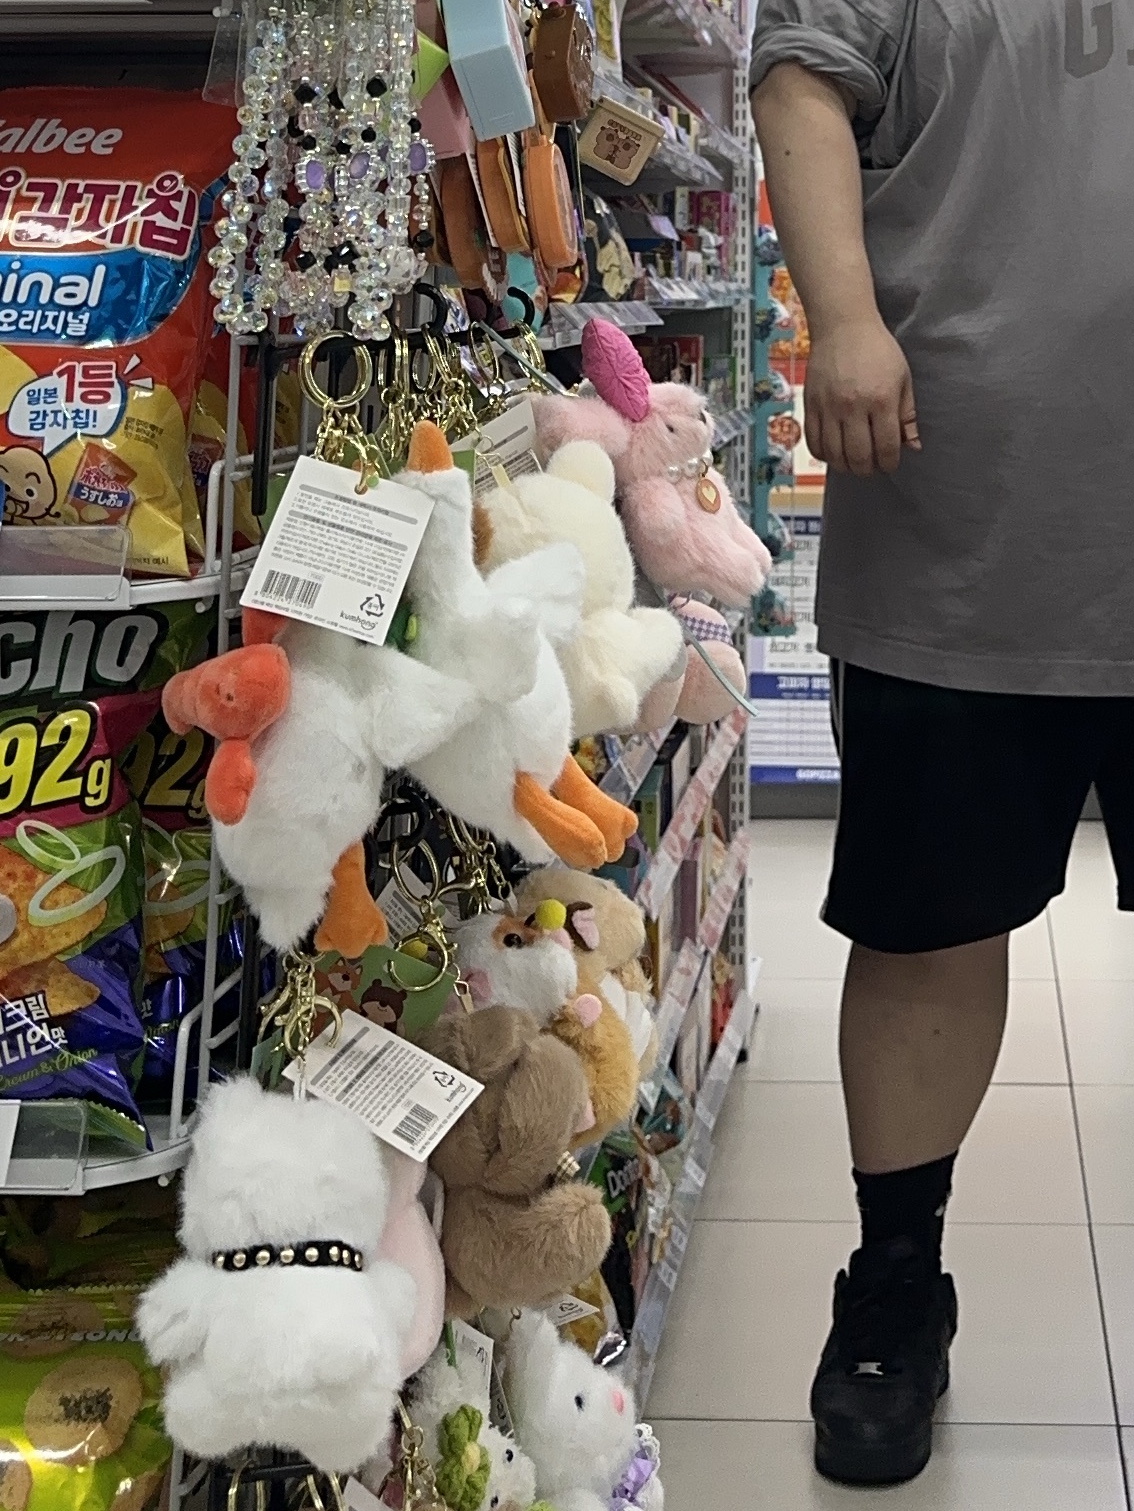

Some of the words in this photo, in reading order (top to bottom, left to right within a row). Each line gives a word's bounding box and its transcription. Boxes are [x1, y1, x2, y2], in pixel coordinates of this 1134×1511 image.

[0, 117, 124, 156] albee
[0, 260, 107, 308] inal
[26, 387, 59, 406] 일본
[54, 360, 117, 405] 1등
[28, 409, 98, 431] 감자칩!
[340, 609, 379, 630] kumhong
[0, 610, 158, 694] cho
[0, 1022, 69, 1068] 니언맛
